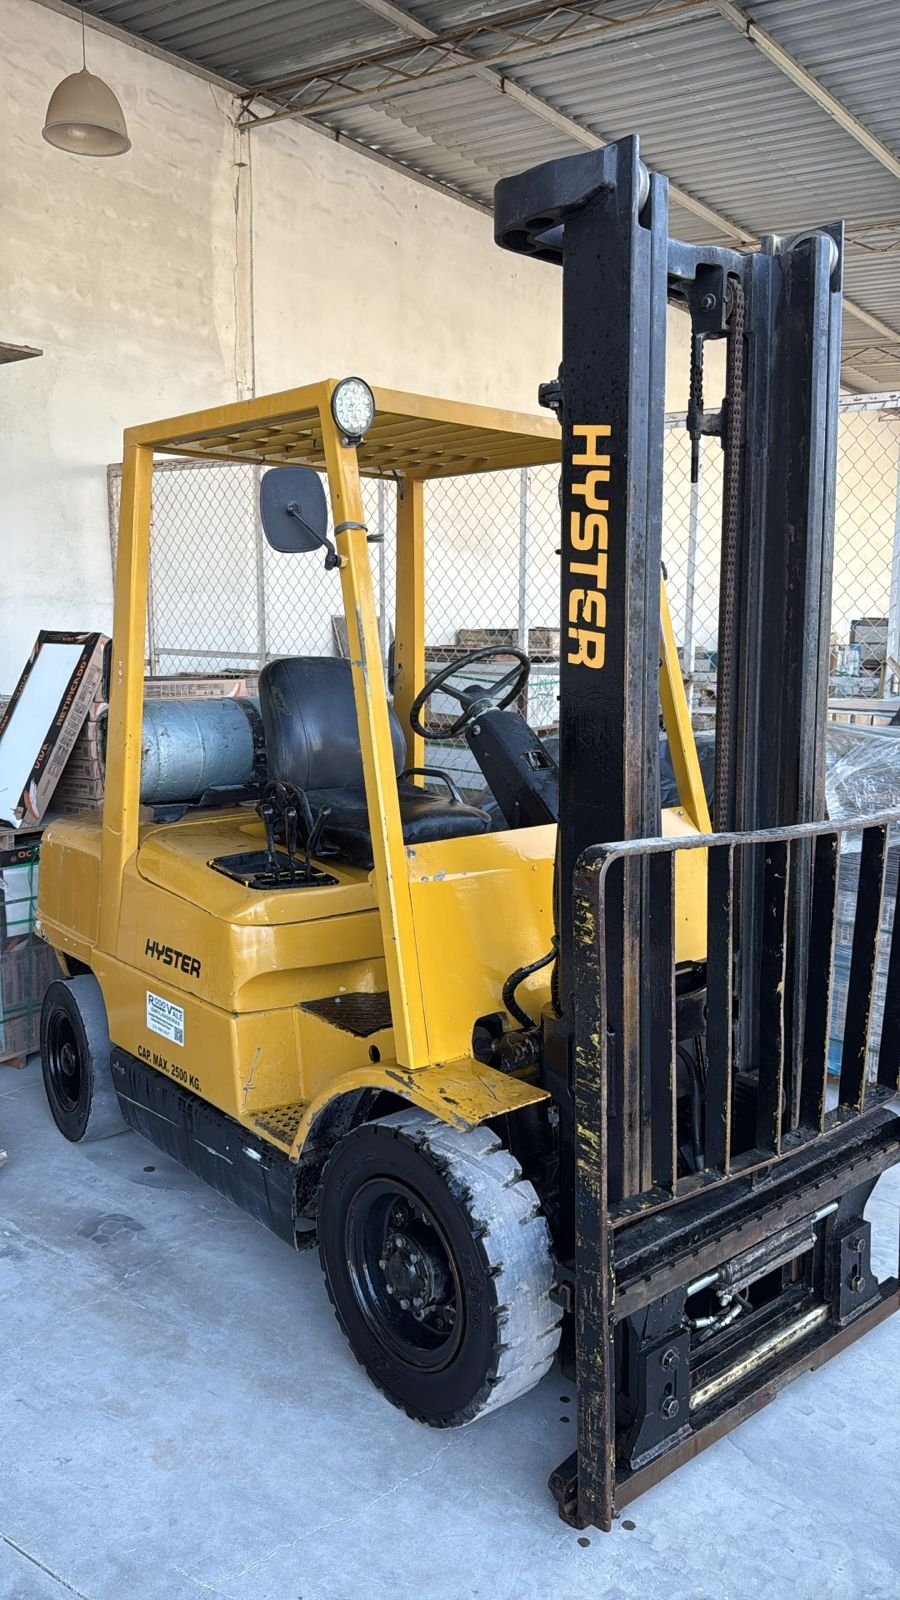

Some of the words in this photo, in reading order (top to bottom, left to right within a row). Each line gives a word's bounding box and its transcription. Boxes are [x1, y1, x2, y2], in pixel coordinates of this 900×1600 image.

[567, 424, 612, 669] HYSTER
[56, 661, 87, 727] RETIFICADO
[34, 742, 49, 769] VIVA
[145, 938, 201, 979] HYSTER
[137, 1045, 152, 1062] CAP.
[153, 1053, 170, 1073] MÁX.
[171, 1064, 187, 1083] 2500
[189, 1074, 202, 1092] KG.
